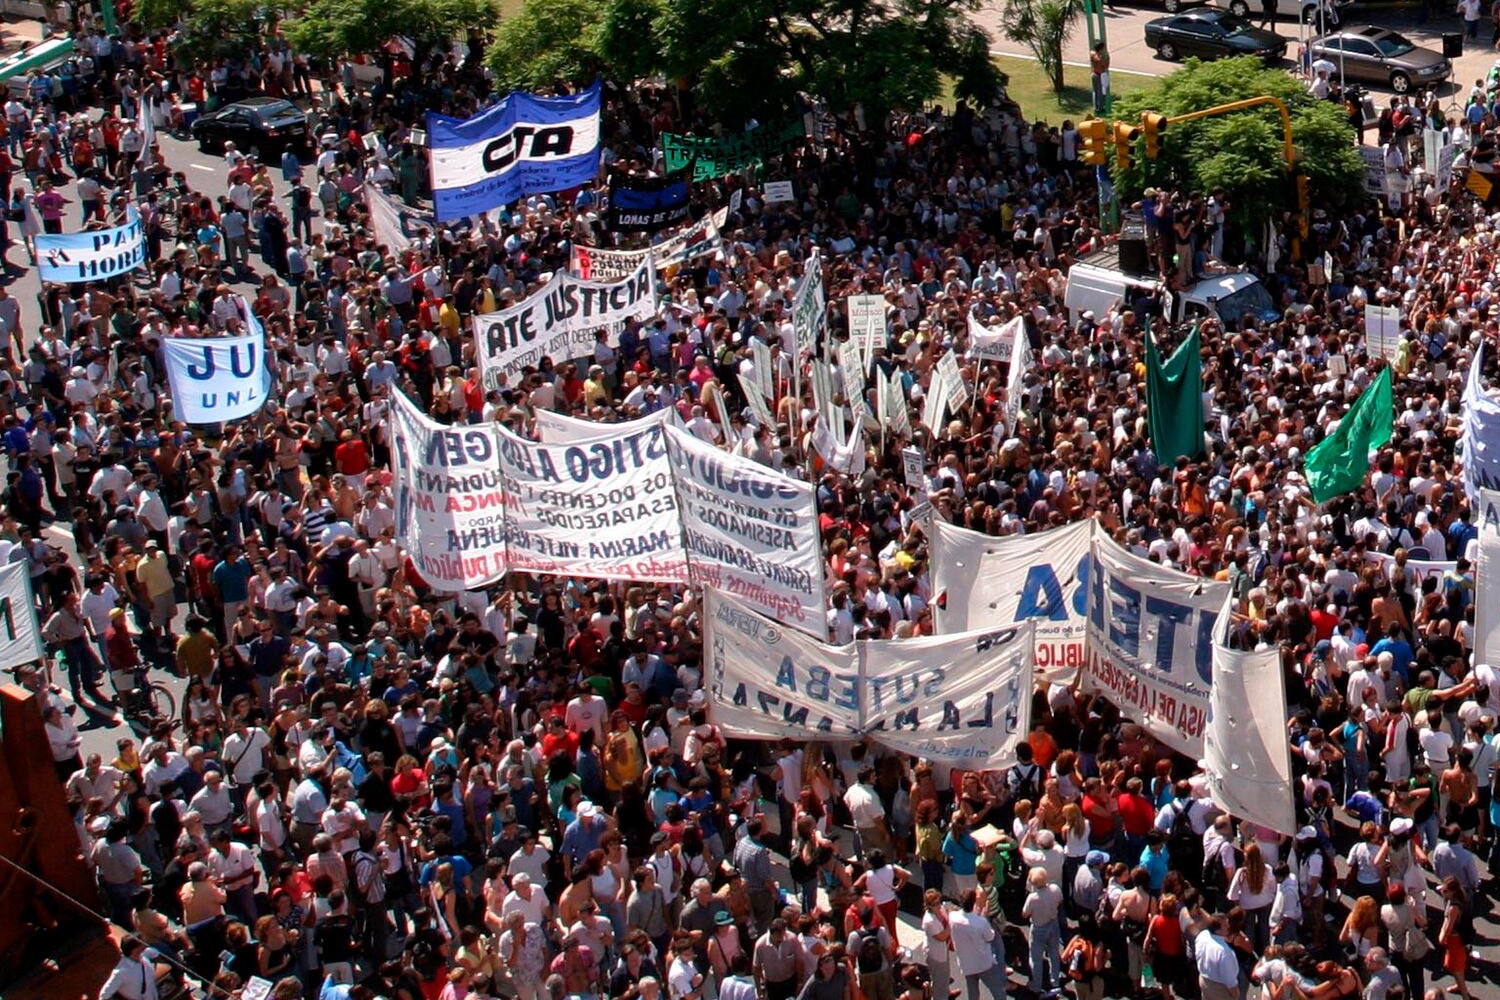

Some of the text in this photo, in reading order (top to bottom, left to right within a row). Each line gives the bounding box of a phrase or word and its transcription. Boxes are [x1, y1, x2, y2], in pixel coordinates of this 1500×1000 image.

[482, 125, 575, 174] CTA
[487, 266, 650, 358] ATE JUSTICIA
[202, 387, 258, 409] UNL
